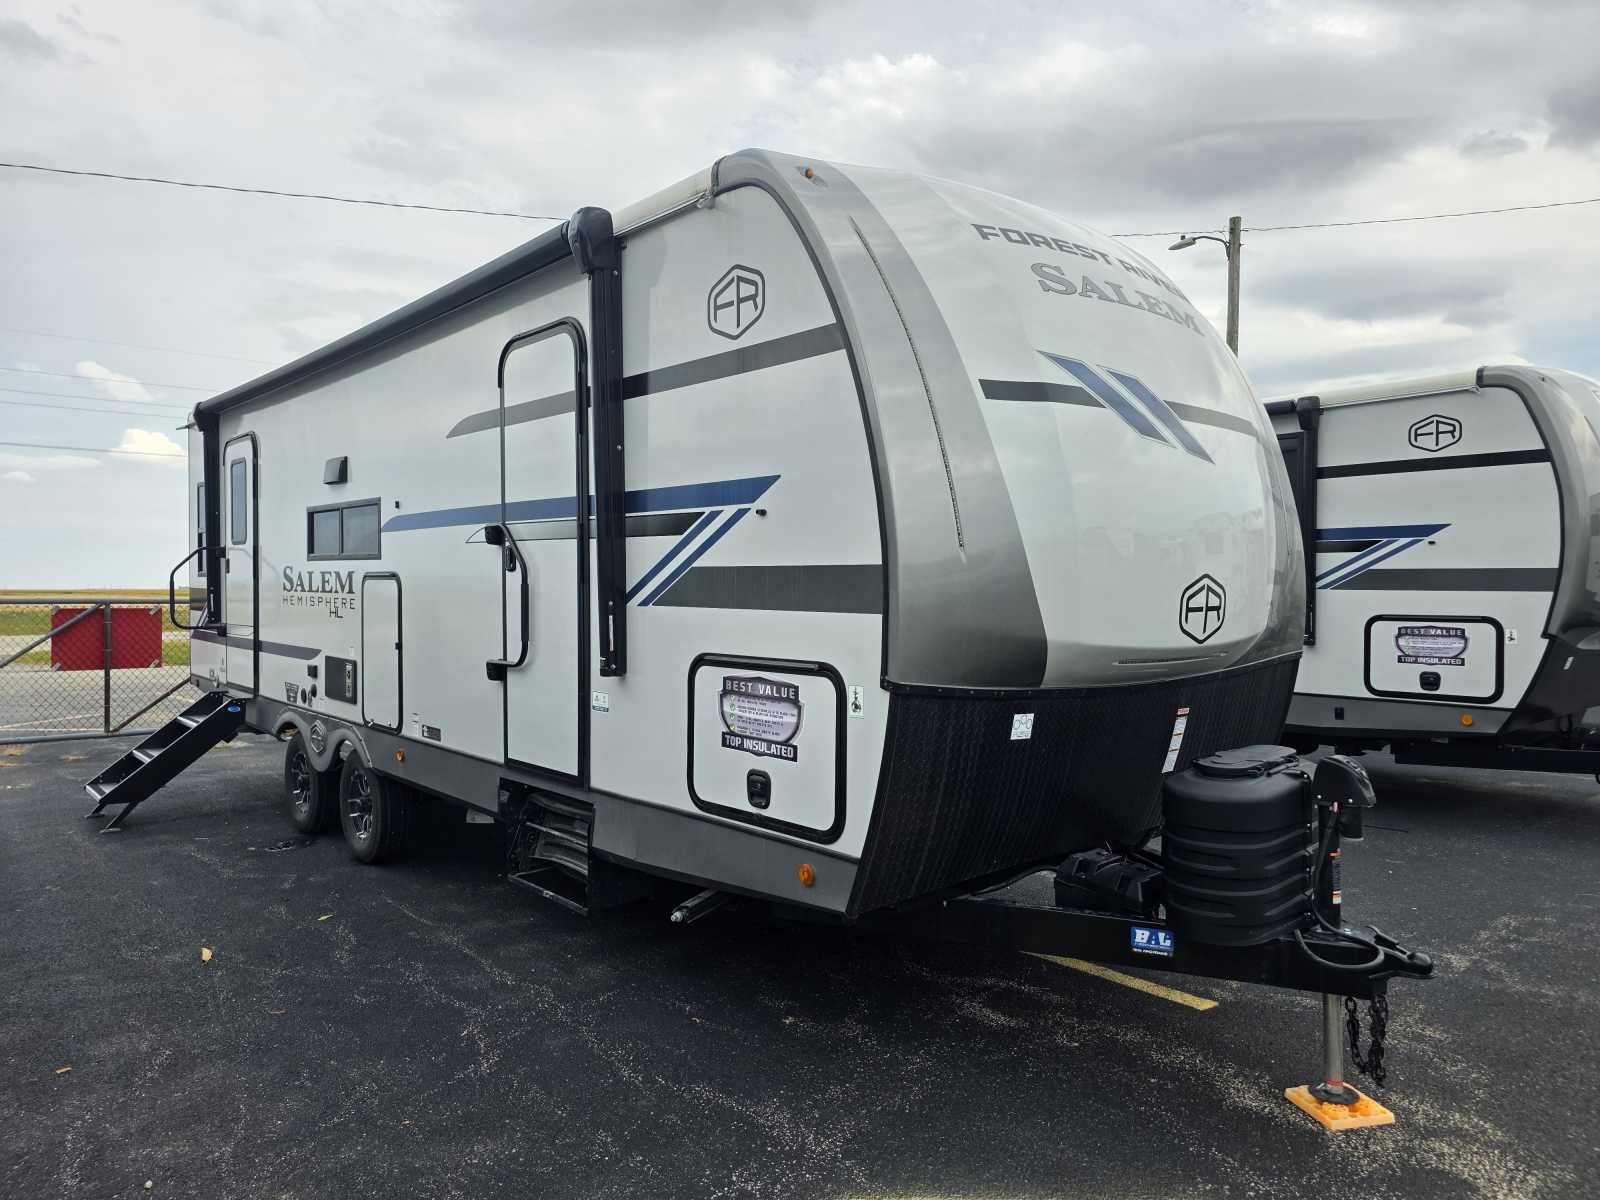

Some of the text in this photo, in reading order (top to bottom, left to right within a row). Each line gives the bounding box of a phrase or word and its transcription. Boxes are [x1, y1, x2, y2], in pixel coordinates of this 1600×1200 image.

[970, 223, 1112, 265] FOREST
[712, 273, 760, 330] FR
[1030, 262, 1206, 337] SALEM
[1412, 418, 1458, 448] FR
[283, 565, 355, 594] SALEM
[282, 595, 356, 609] HEMISPHERE
[328, 607, 345, 619] HL
[1429, 628, 1463, 636] VALUE
[1417, 657, 1462, 665] INSULATED
[726, 680, 796, 699] BEST VALUE
[725, 735, 794, 758] TOP INSULATED
